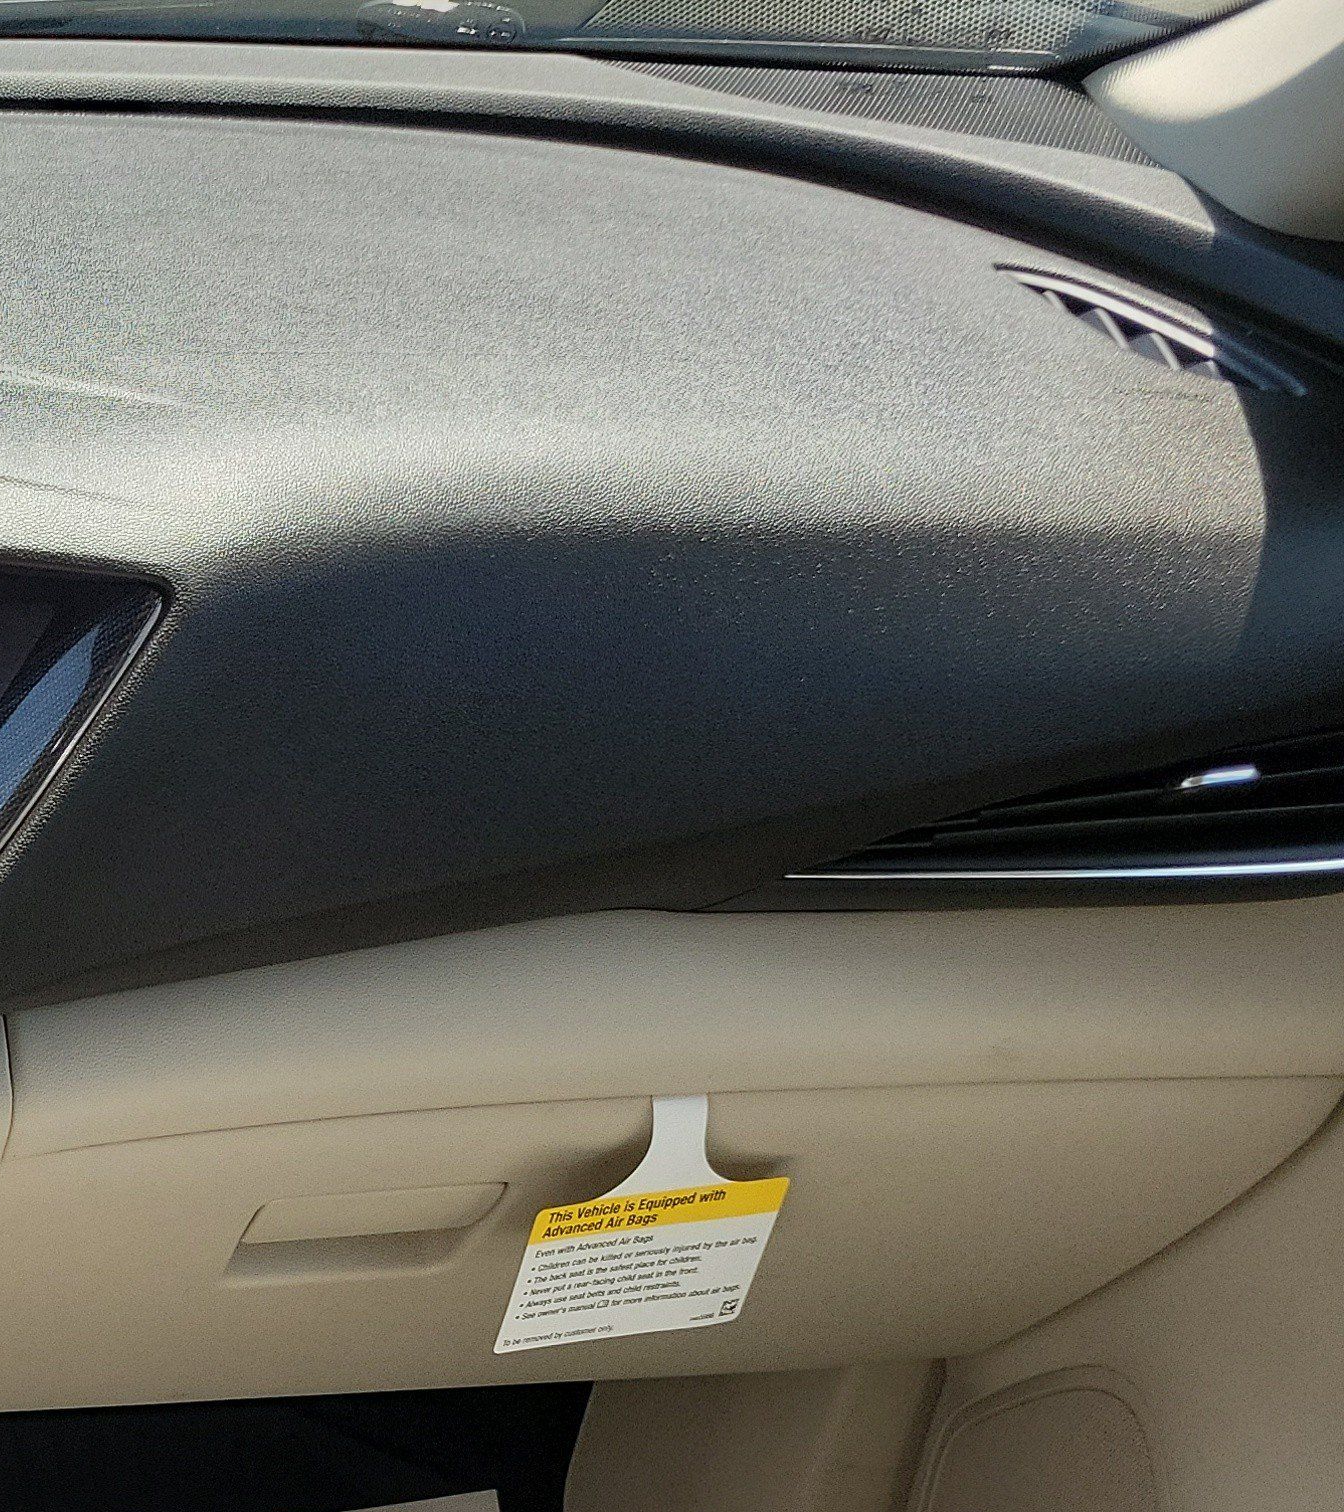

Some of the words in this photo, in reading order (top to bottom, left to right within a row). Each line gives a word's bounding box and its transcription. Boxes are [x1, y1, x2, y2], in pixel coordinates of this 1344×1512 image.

[548, 1211, 574, 1224] This
[577, 1202, 621, 1219] Vehicle
[623, 1200, 635, 1212] is
[638, 1192, 697, 1214] Equipped
[699, 1189, 727, 1203] with
[541, 1222, 602, 1240] Advanced
[604, 1216, 623, 1230] Air
[626, 1212, 658, 1228] Bags
[535, 1249, 555, 1259] Even
[557, 1245, 576, 1255] with
[577, 1239, 617, 1252] Advanced
[619, 1236, 632, 1246] Air
[632, 1235, 654, 1244] Bags
